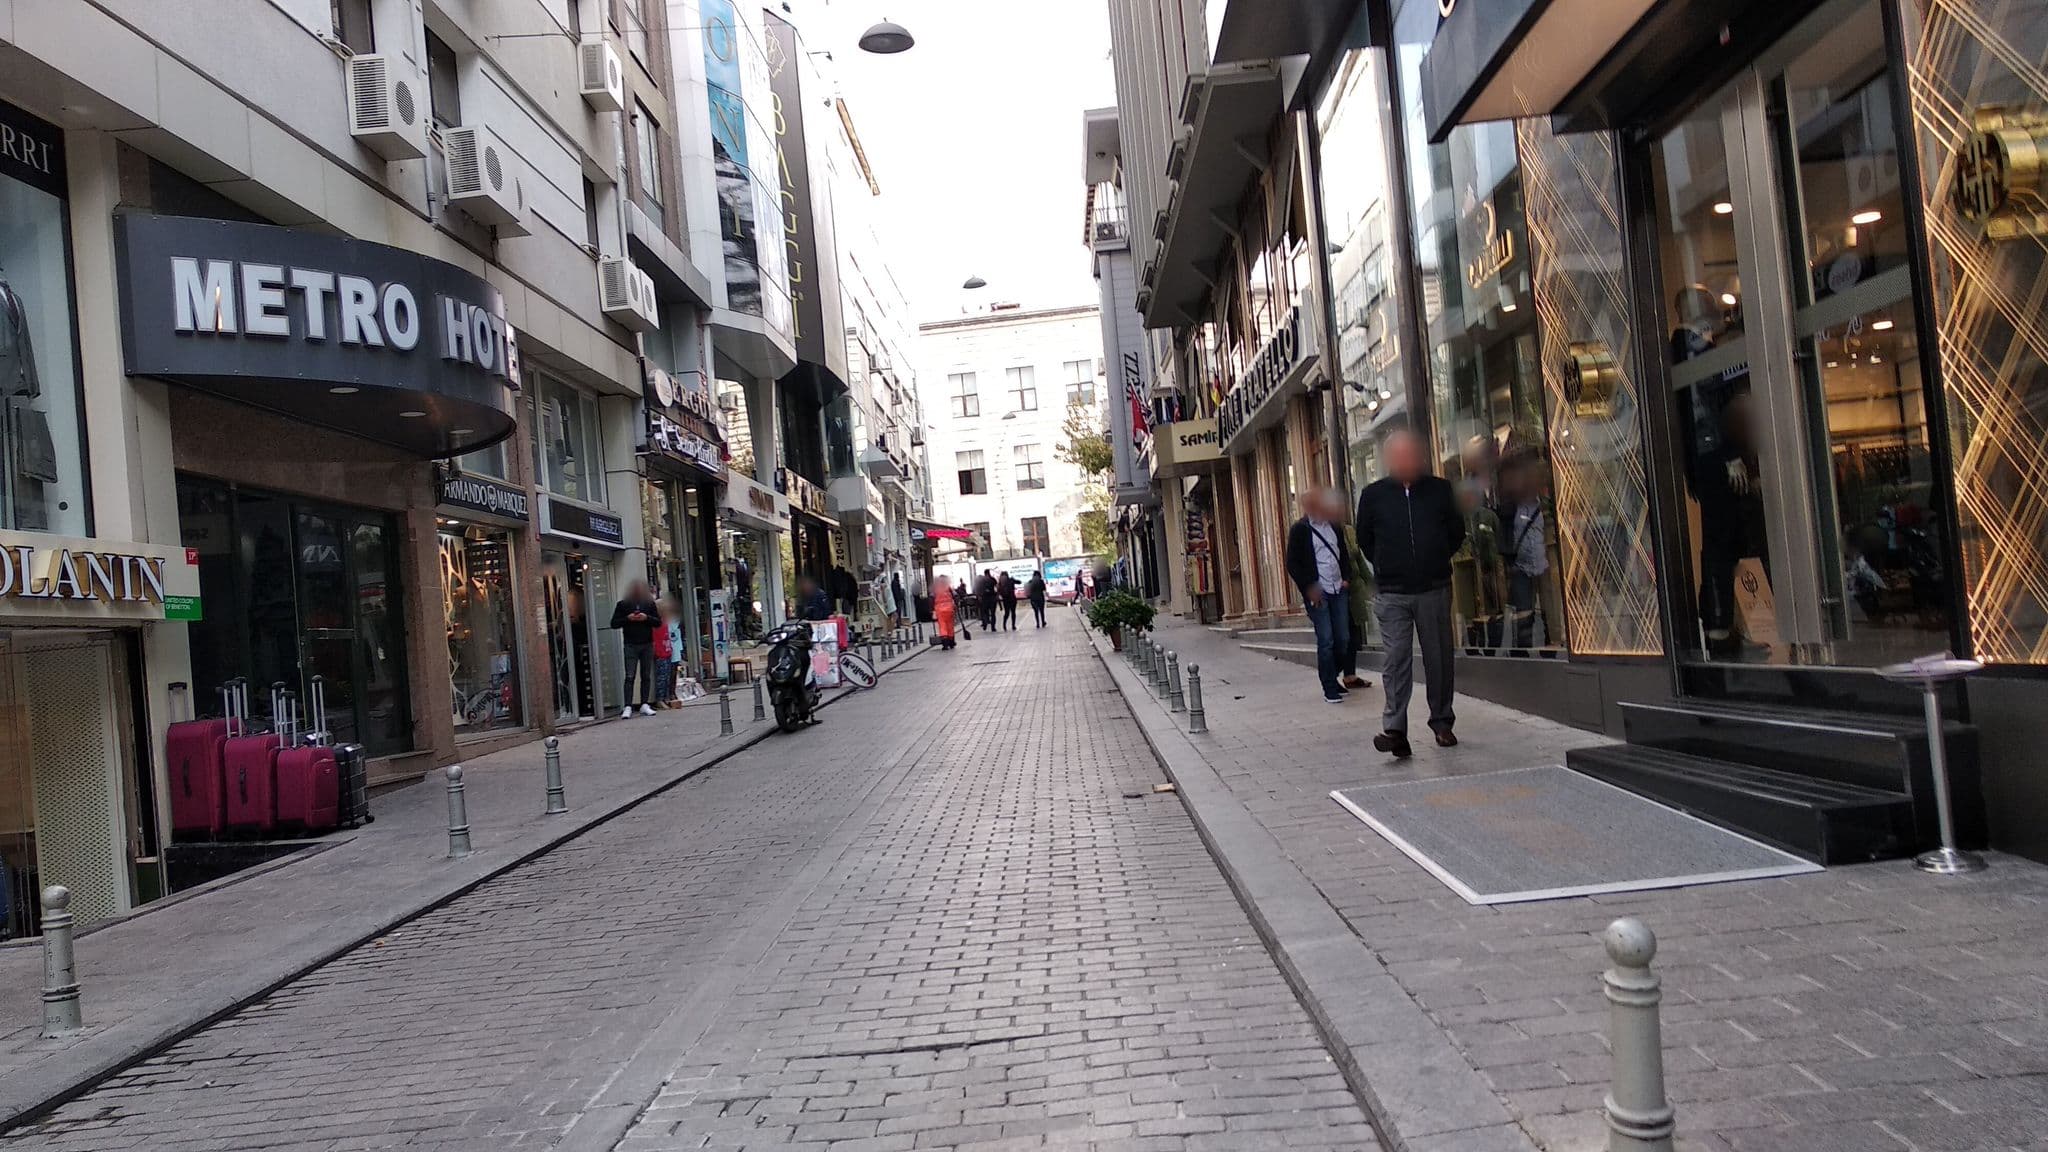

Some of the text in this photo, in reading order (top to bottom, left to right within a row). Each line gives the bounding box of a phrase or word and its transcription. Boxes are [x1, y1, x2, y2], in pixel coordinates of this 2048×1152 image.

[170, 256, 420, 350] METRO
[444, 480, 528, 517] ARMANDO MARQUEZ
